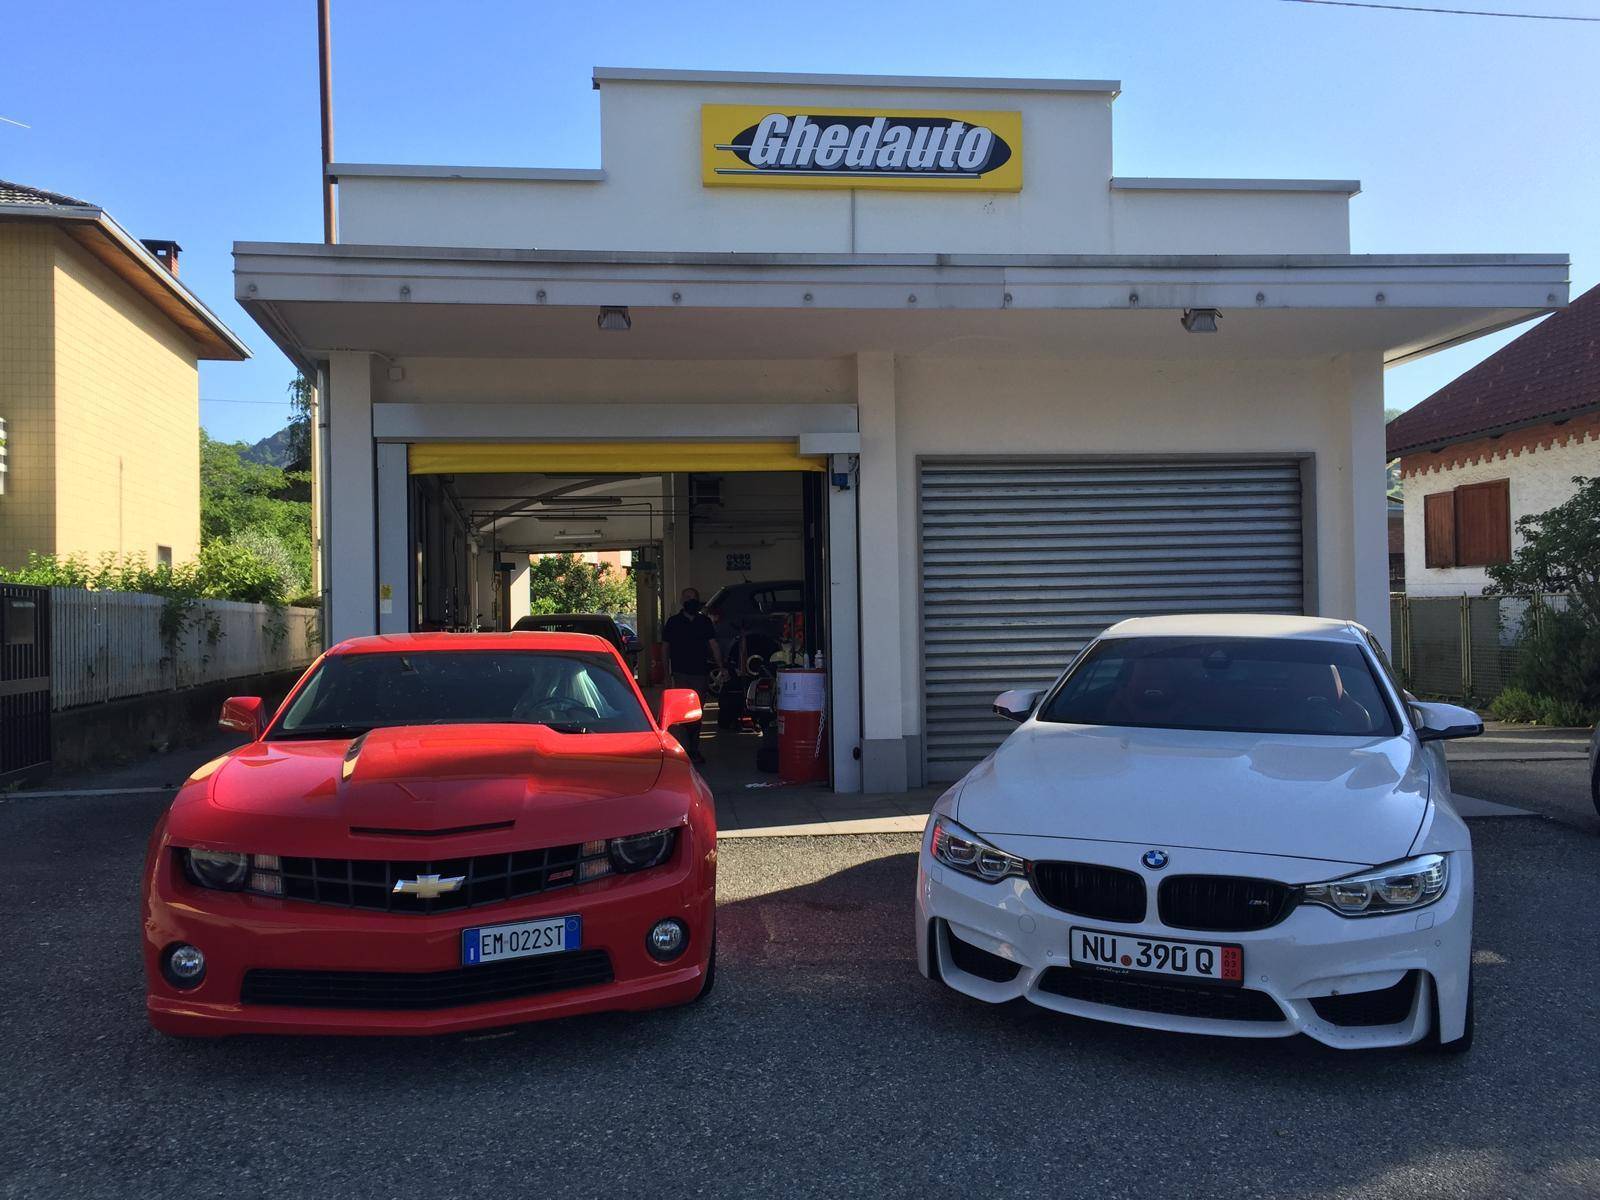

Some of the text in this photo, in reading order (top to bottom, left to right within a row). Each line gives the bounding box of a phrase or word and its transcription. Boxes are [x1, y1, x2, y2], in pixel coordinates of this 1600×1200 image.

[749, 113, 995, 170] Ghedauto
[481, 925, 564, 956] EM 022ST
[1082, 933, 1214, 975] NU 390 Q
